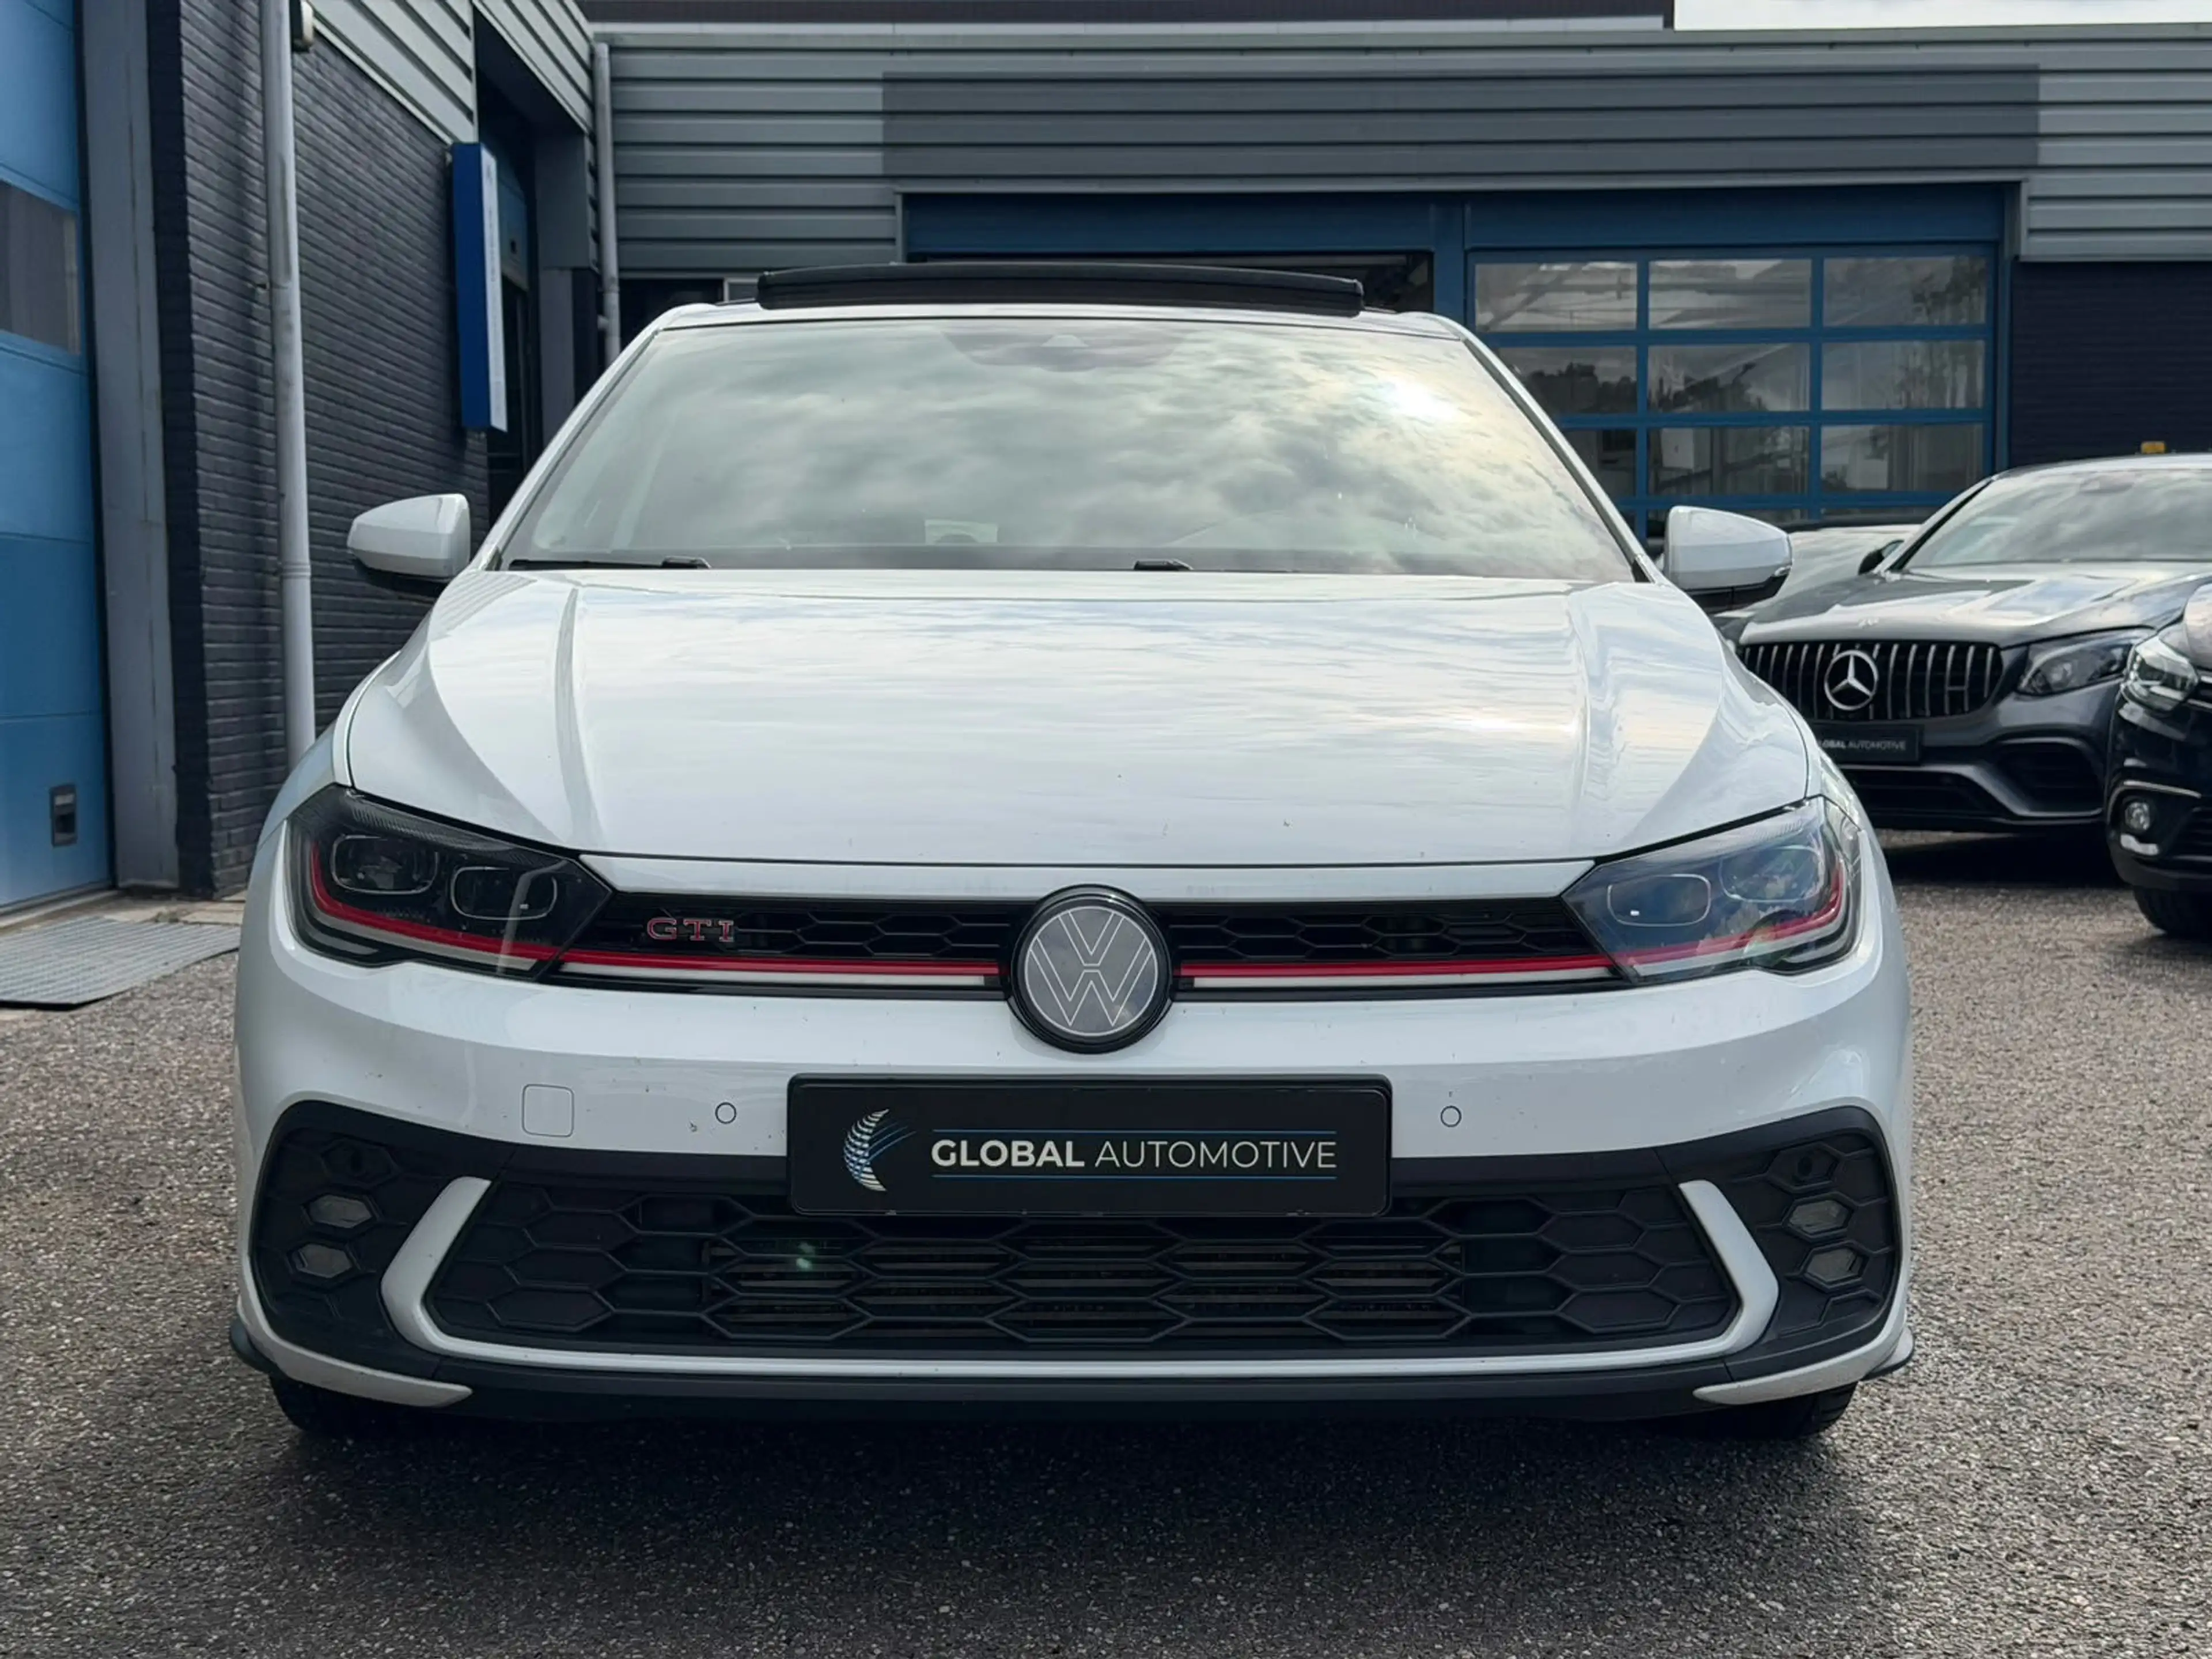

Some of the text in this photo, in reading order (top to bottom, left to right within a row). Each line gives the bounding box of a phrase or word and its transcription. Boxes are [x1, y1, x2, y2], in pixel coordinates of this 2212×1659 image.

[1847, 740, 1907, 751] AUTOMOTIVE
[647, 917, 734, 942] GTI
[931, 1139, 1337, 1168] GLOBAL AUTOMOTIVE
